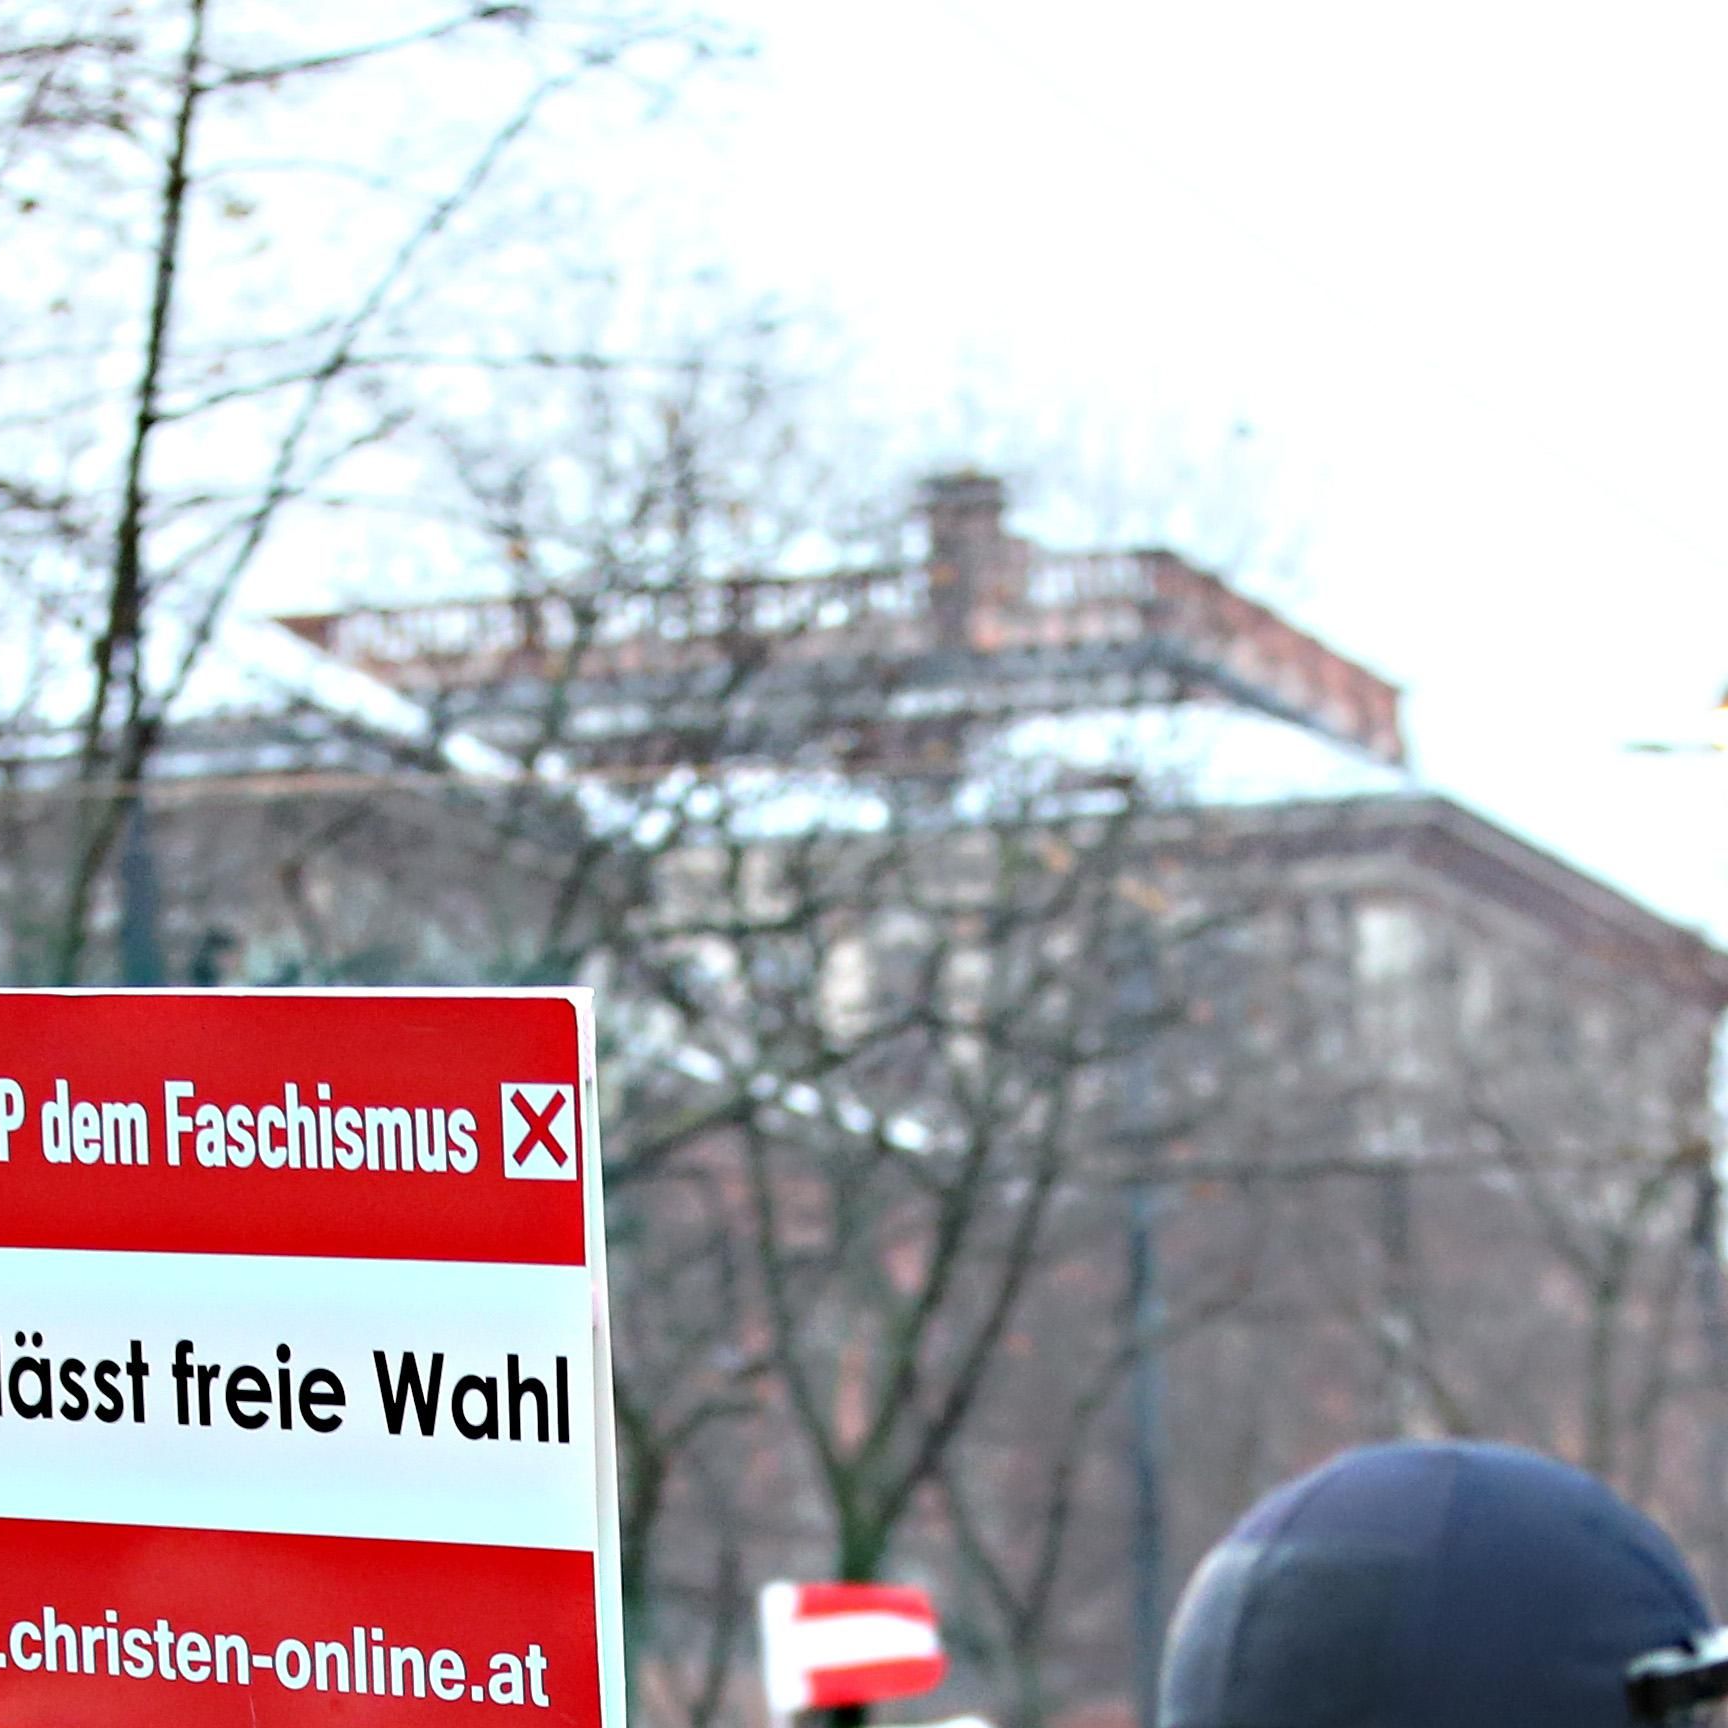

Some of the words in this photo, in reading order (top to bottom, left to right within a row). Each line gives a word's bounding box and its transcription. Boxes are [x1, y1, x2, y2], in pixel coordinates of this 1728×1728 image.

[41, 1078, 150, 1166] dem
[164, 1080, 479, 1174] Faschismus
[171, 1339, 346, 1433] freie
[373, 1350, 570, 1444] Wahl
